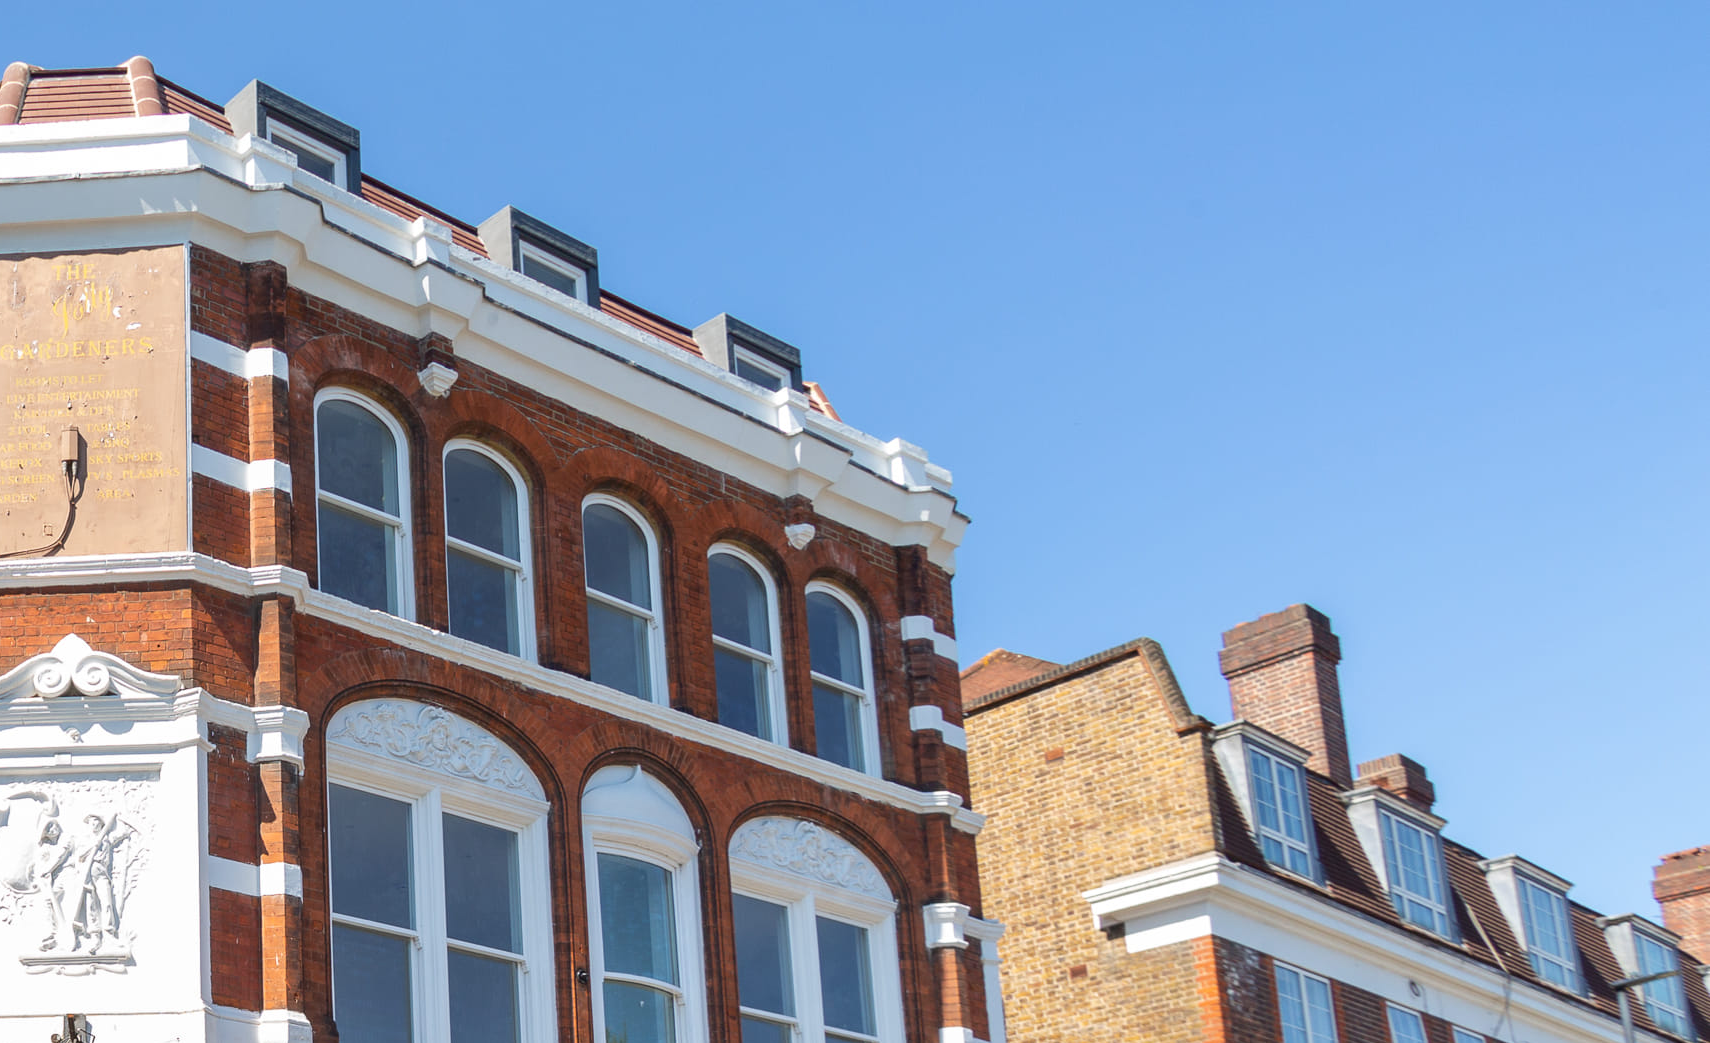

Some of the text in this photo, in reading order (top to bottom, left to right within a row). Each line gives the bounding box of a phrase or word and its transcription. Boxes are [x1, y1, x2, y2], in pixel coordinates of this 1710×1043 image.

[52, 263, 96, 281] THE
[0, 336, 154, 361] GARDENERS
[15, 374, 105, 386] ROOMS TO LET
[6, 388, 140, 404] LIVE ENTERTAINMENT
[17, 424, 48, 435] POOL
[87, 422, 131, 433] TABLES
[18, 441, 52, 452] FOOD
[89, 455, 112, 465] SKY
[117, 452, 163, 464] SPORTS
[8, 473, 56, 486] SCREEN
[122, 468, 181, 481] PLASMAS
[97, 488, 131, 499] AREA
